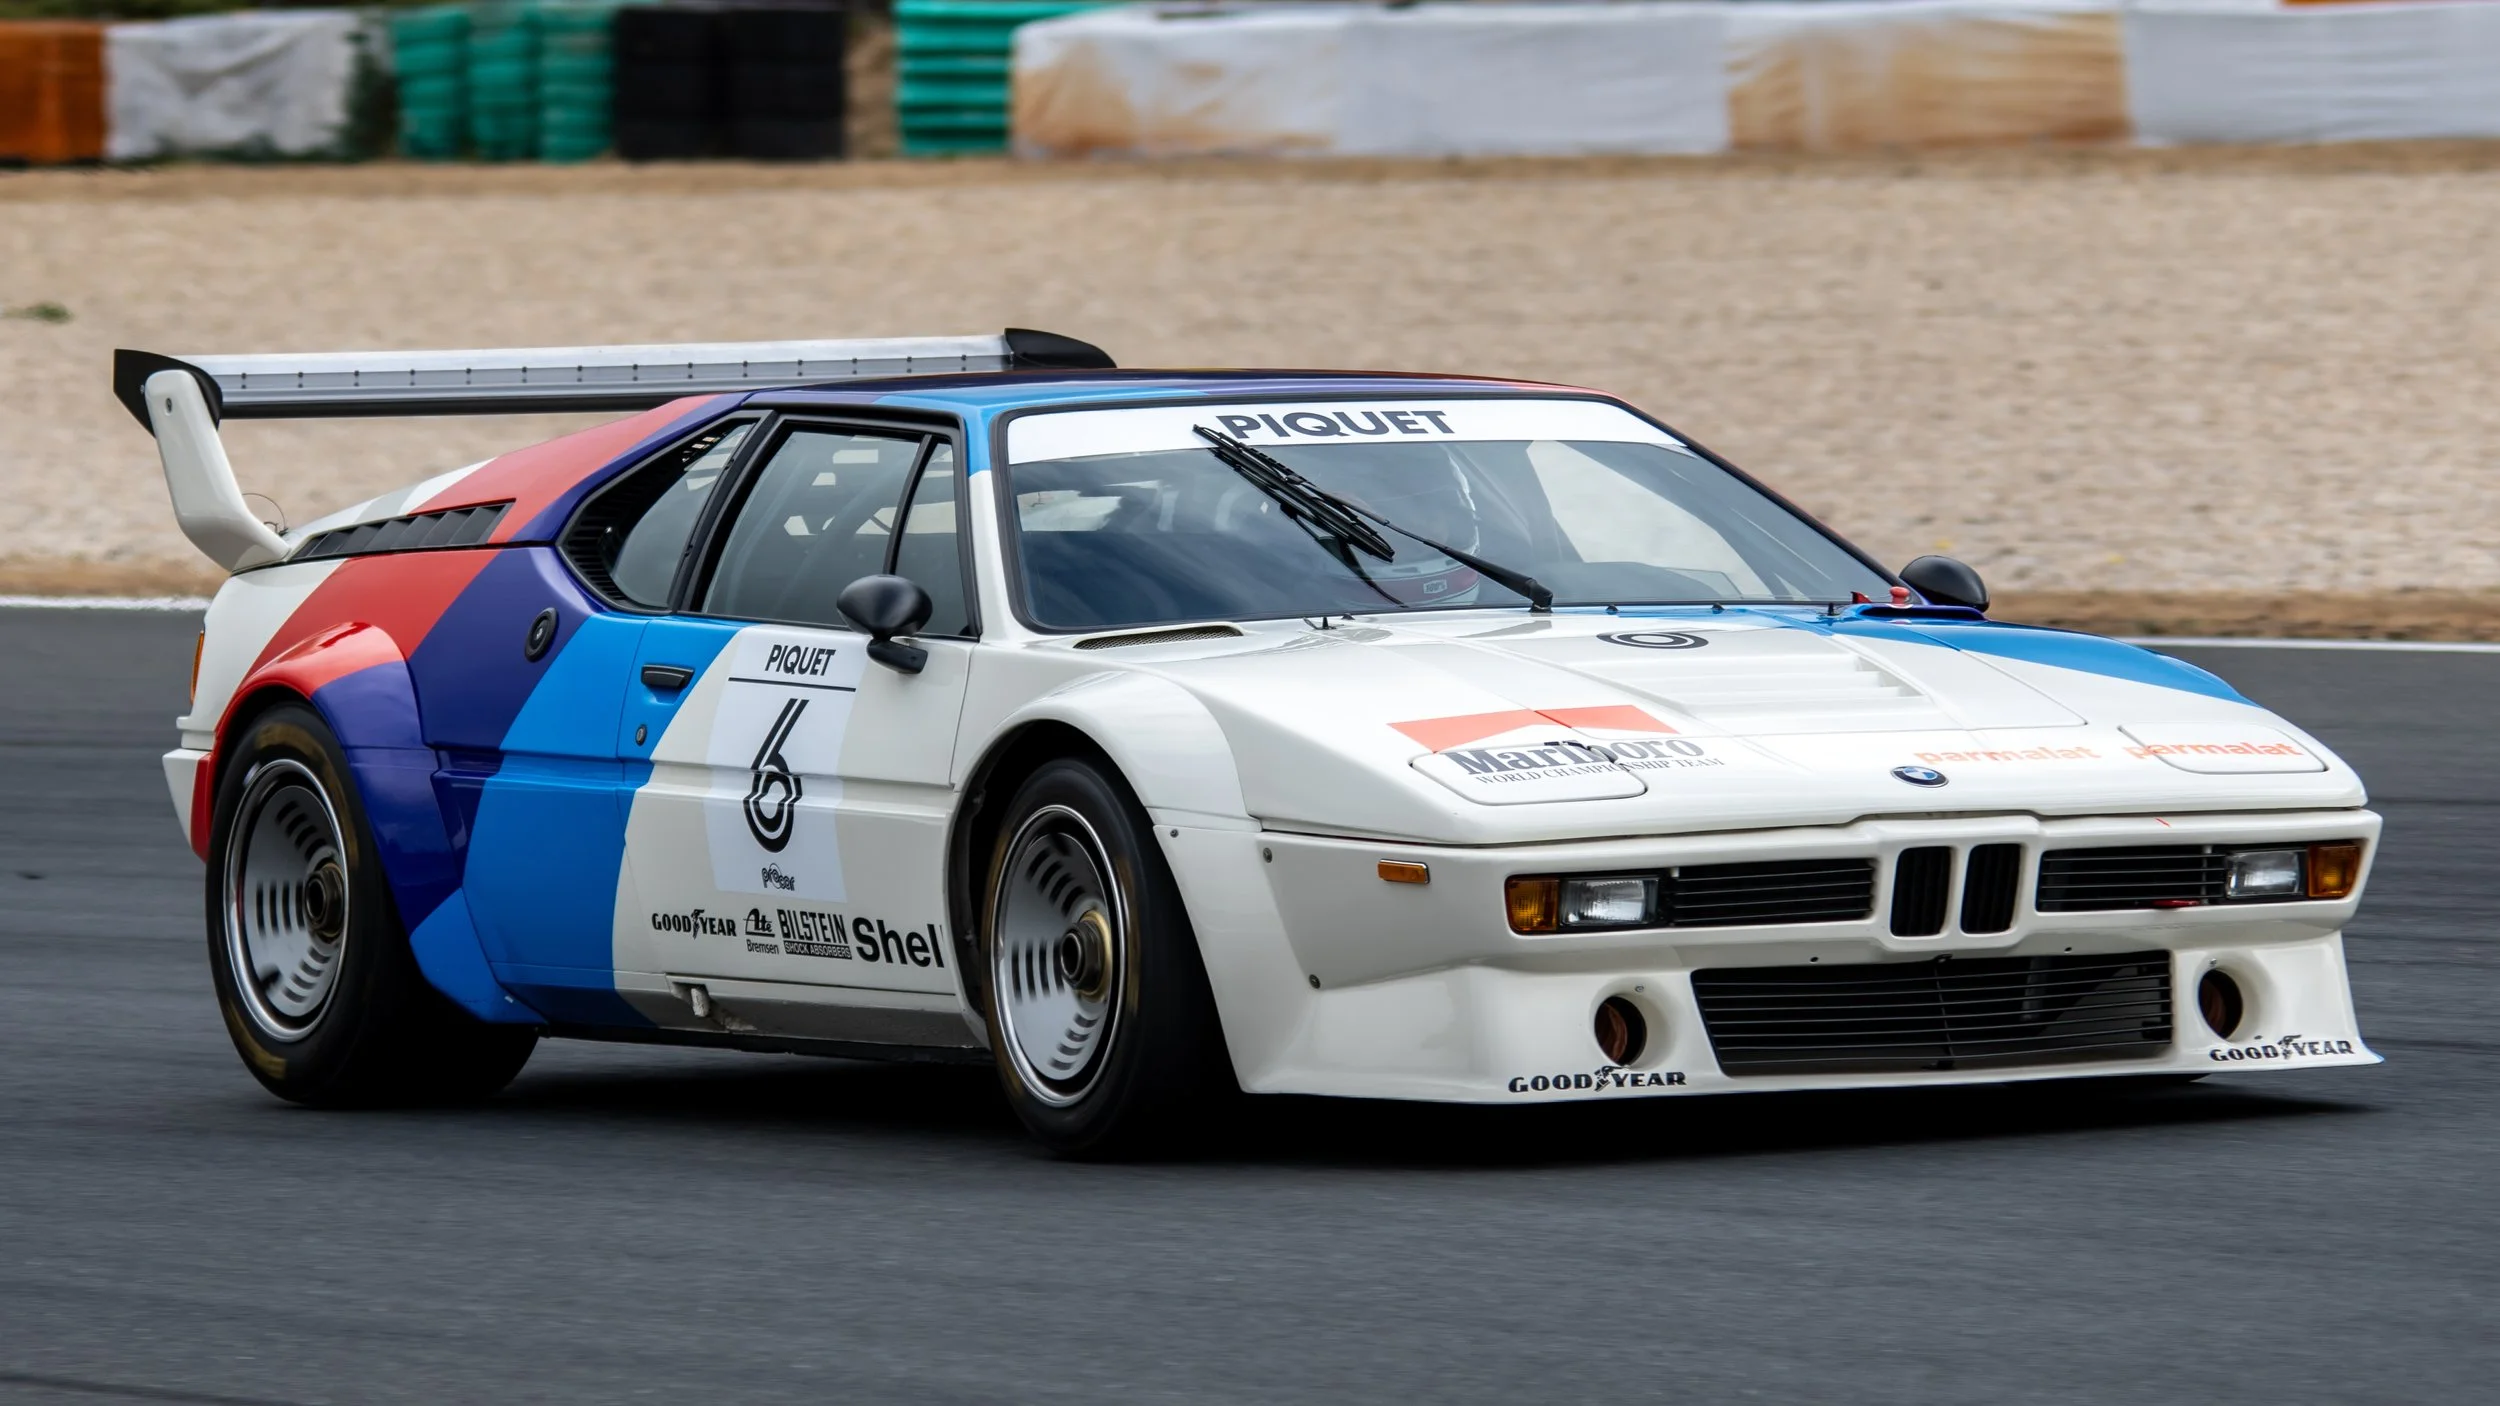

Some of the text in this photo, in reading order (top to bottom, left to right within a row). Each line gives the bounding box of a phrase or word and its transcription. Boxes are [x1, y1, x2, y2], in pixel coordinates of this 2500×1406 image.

[1216, 410, 1455, 440] PIQUET
[765, 644, 836, 676] PIQUET
[1444, 739, 1704, 775] Marlboro
[1912, 746, 2101, 765] parmalat
[2122, 742, 2303, 760] parmalat
[743, 698, 809, 853] 6
[1475, 757, 1725, 784] WORLD CHAMPIONSHIP TEAM
[651, 909, 737, 938] GOODYEAR
[776, 908, 848, 944] BILSTEIN
[746, 938, 779, 955] Bremsen
[784, 942, 850, 958] SHOCK ABSORBERS
[852, 917, 945, 968] Shel
[2209, 1035, 2354, 1061] GOODYEAR
[1508, 1066, 1687, 1093] GOODYEAR
